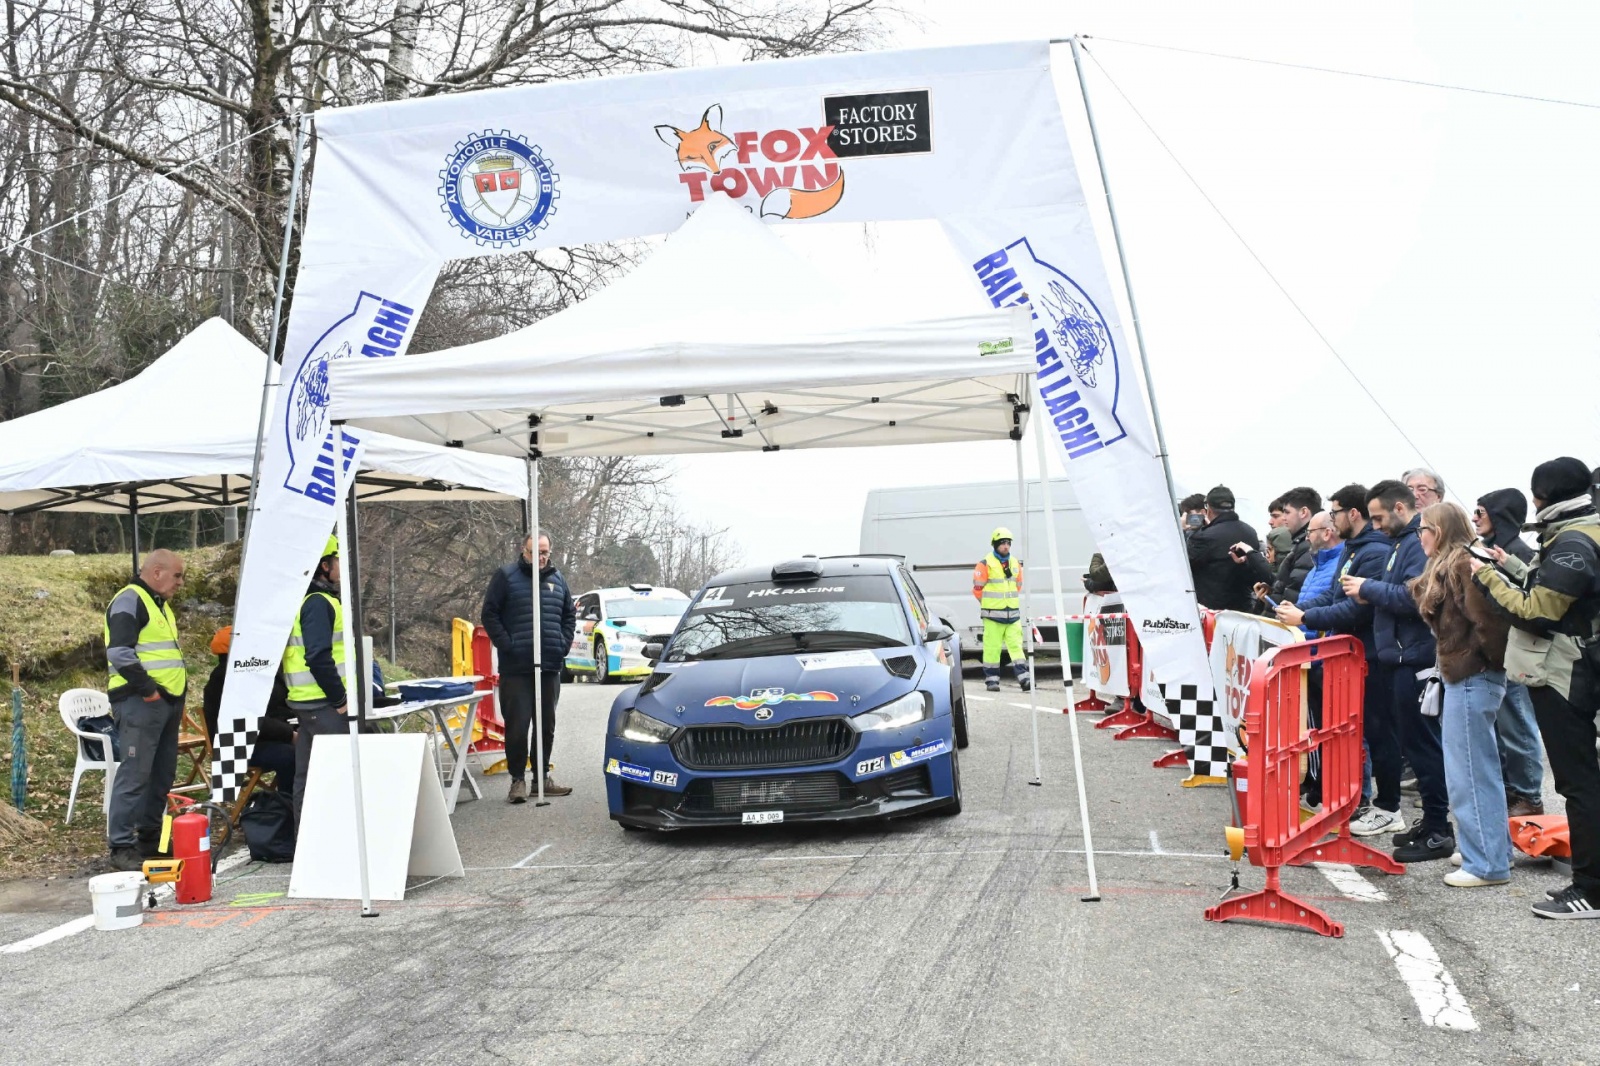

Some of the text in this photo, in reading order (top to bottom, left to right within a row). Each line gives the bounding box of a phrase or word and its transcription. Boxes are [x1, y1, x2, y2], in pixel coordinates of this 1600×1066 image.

[839, 103, 917, 125] FACTORY
[734, 125, 838, 164] FOX
[839, 124, 917, 146] STORES
[447, 138, 552, 204] AUTOMOBILE CLUB
[679, 163, 840, 203] TOWN
[475, 219, 536, 241] VARESE
[360, 298, 414, 358] AGHI
[973, 248, 1039, 320] RAL
[1039, 375, 1105, 460] LAGHI
[705, 588, 719, 600] 4
[747, 586, 846, 598] HK RACING
[911, 743, 945, 757] MICHELIN
[621, 765, 650, 777] MICHELIN
